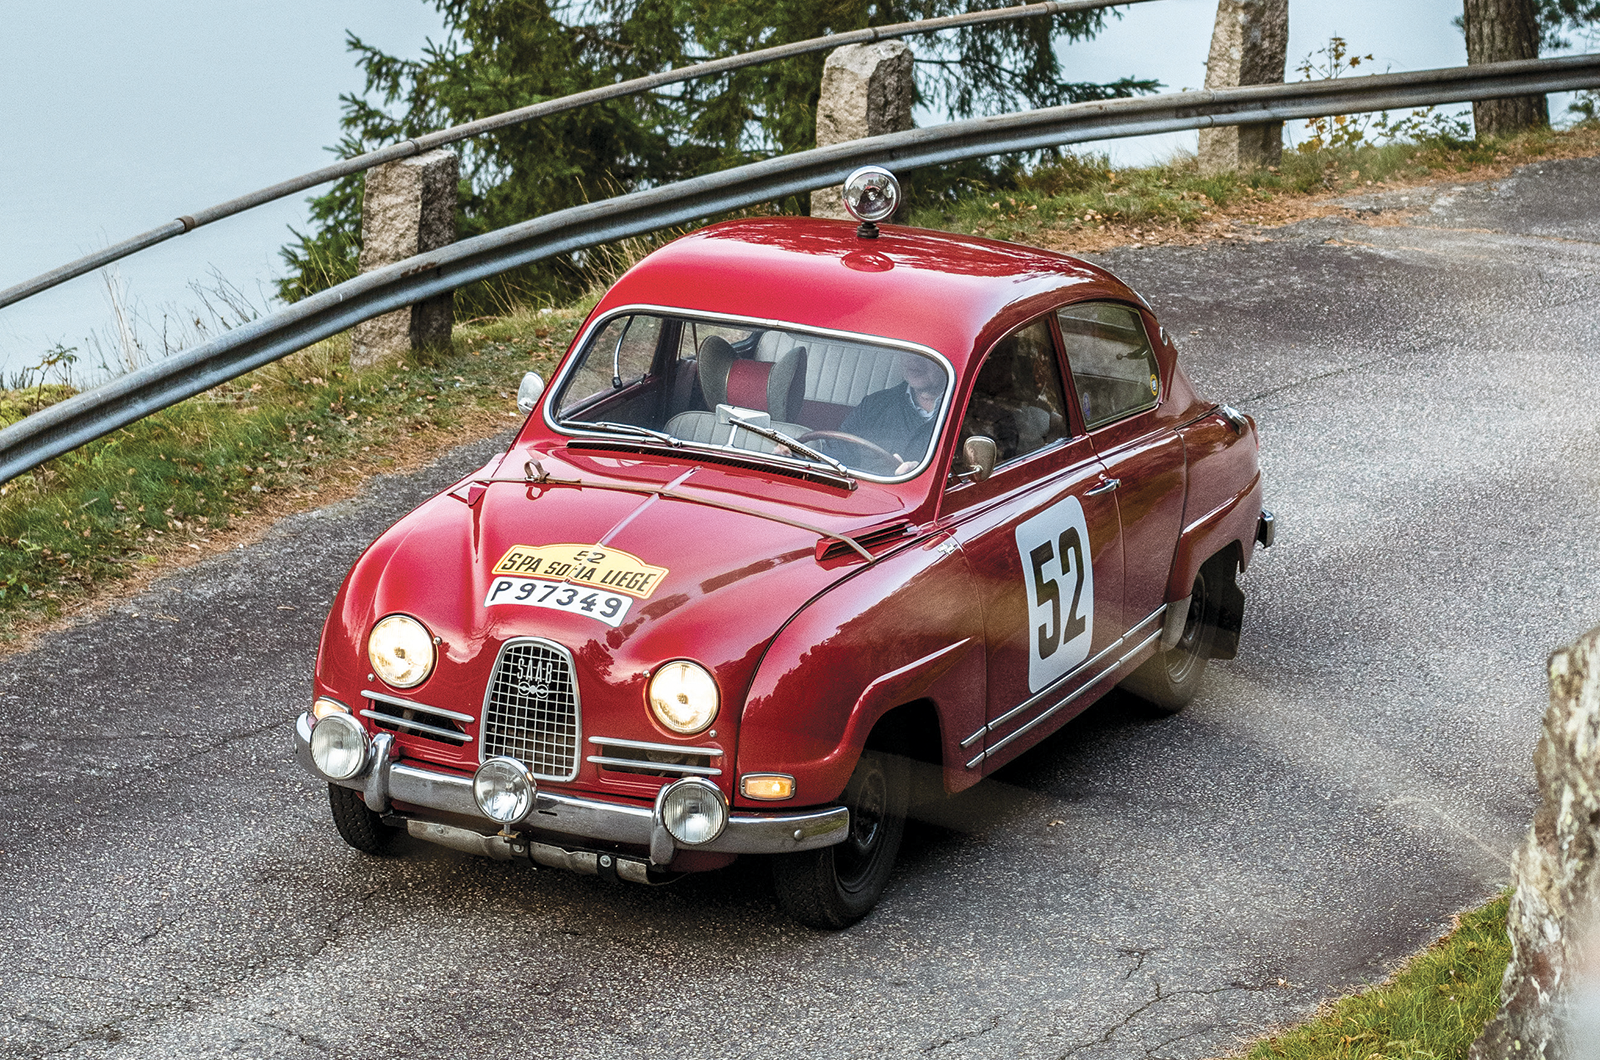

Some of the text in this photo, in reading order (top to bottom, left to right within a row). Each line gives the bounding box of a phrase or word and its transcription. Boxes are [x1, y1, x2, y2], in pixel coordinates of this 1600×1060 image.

[501, 552, 657, 592] SPA SOIA LIEGE
[573, 550, 606, 564] 52
[1029, 526, 1086, 660] 52
[516, 658, 553, 684] SAAB
